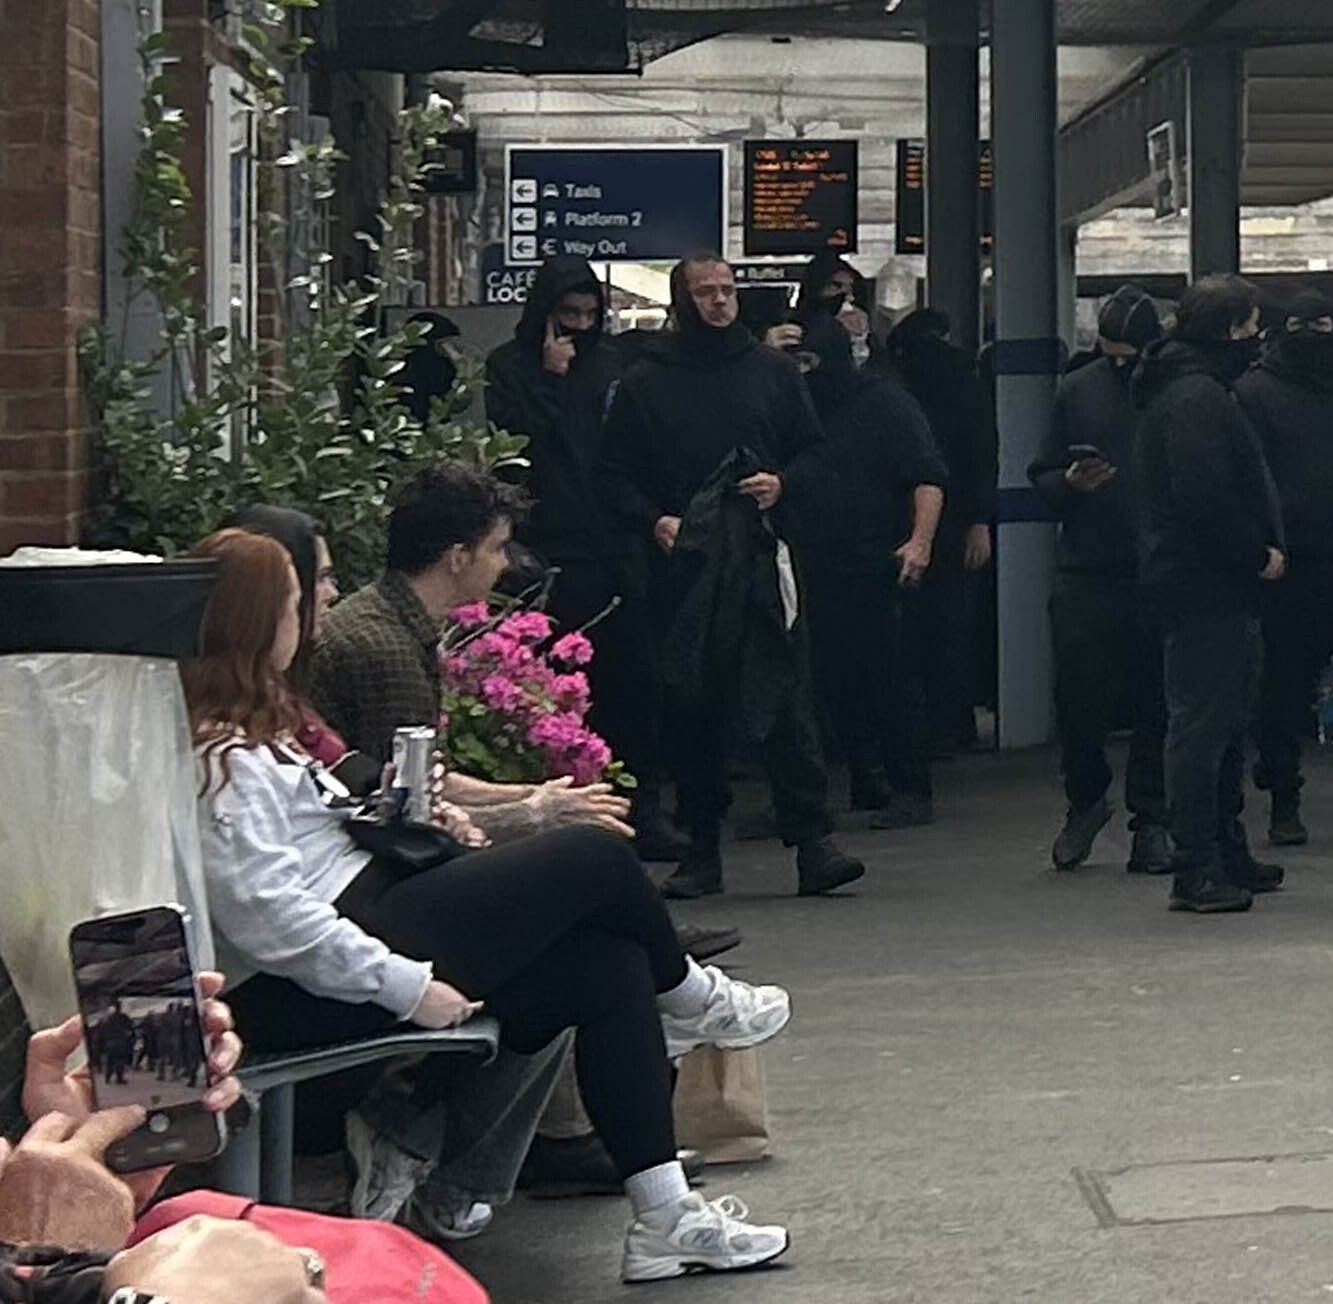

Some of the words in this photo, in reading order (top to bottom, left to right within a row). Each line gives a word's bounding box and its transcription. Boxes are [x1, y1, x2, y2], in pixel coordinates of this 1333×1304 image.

[563, 183, 602, 198] Taxis
[563, 211, 629, 227] Platform
[631, 211, 643, 227] 2
[563, 239, 595, 257] Way
[598, 239, 627, 255] Out
[487, 287, 528, 303] LOC
